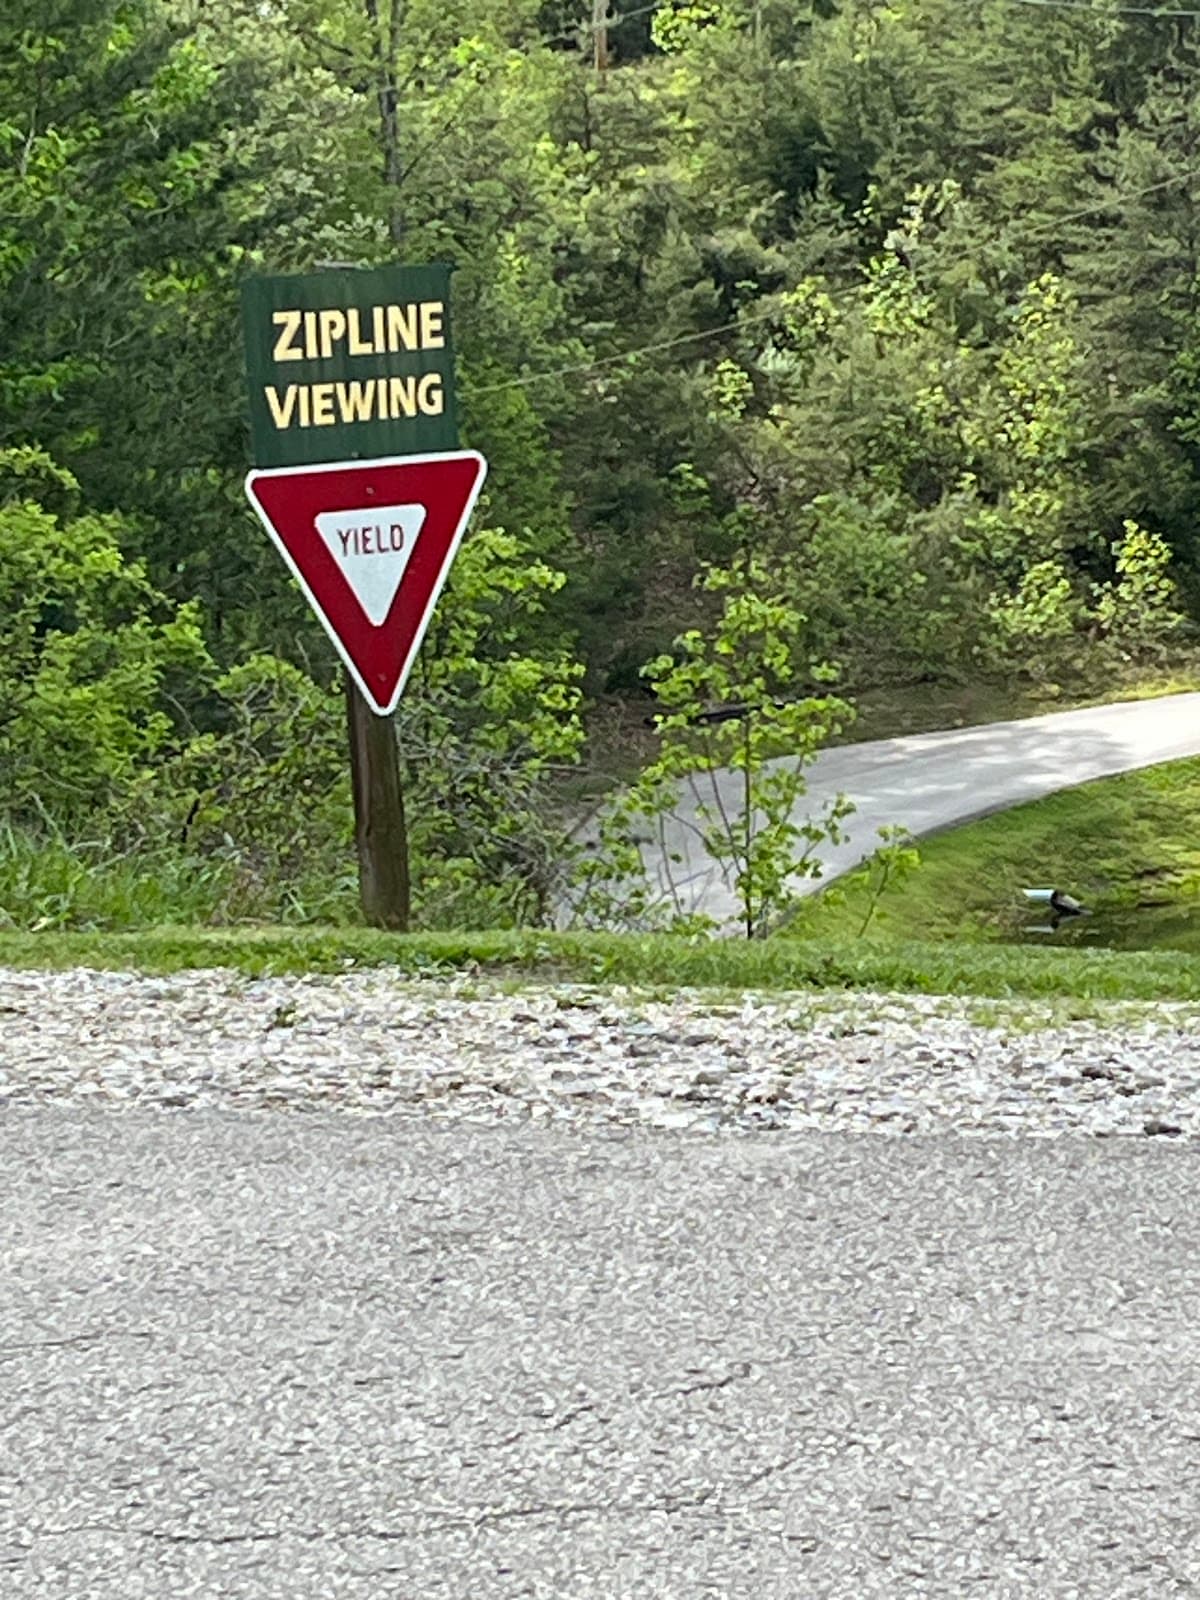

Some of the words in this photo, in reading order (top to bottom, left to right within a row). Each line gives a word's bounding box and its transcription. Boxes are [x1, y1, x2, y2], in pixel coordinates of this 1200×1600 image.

[272, 301, 445, 362] ZIPLINE
[264, 373, 443, 429] VIEWING
[336, 524, 405, 557] YIELD
